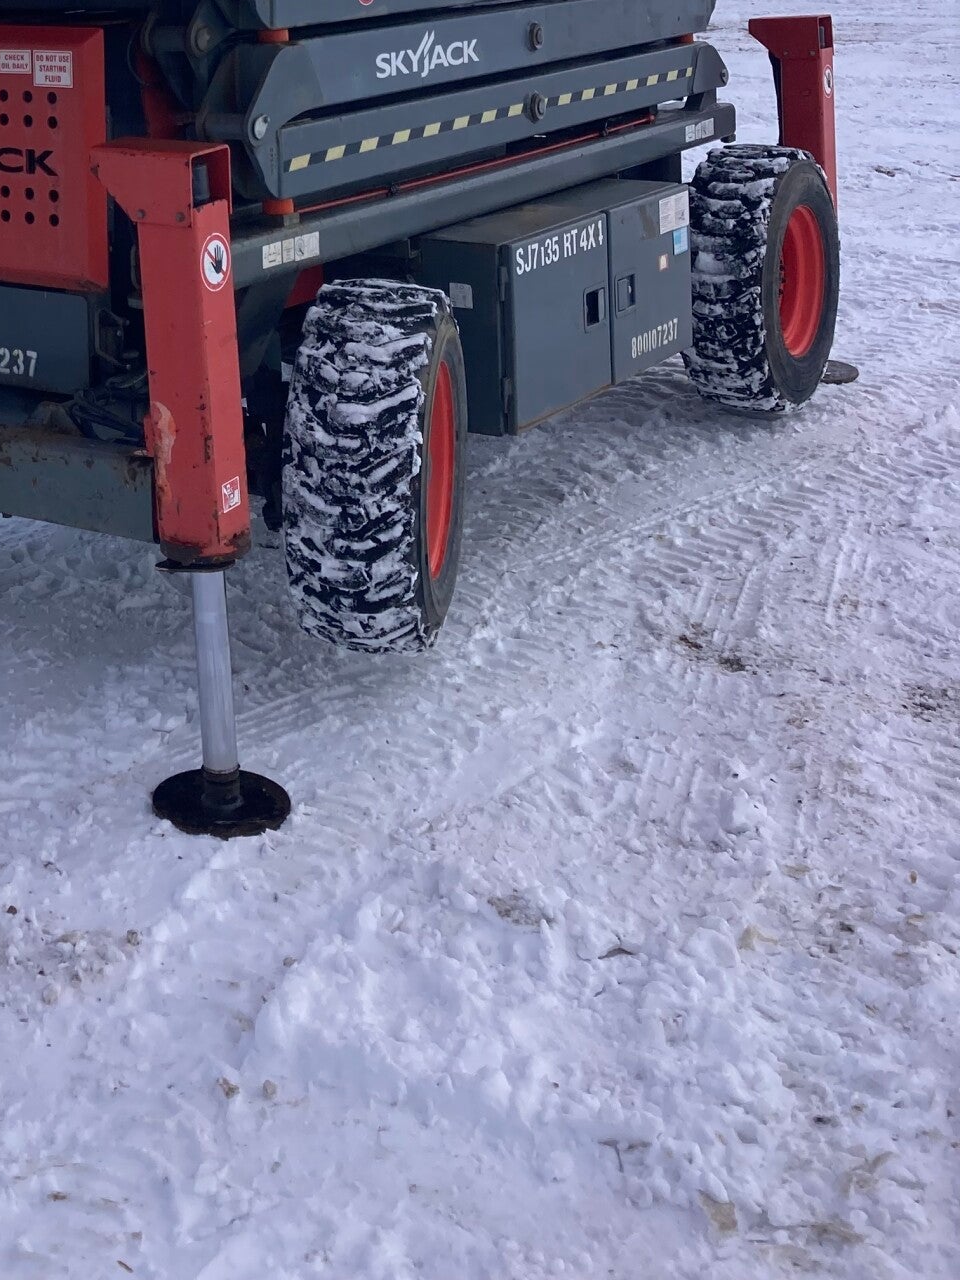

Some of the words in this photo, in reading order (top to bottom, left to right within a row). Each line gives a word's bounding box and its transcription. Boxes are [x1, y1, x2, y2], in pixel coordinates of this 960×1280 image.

[35, 54, 44, 62] DO
[58, 55, 70, 63] USE
[375, 29, 480, 79] SKYJACK
[1, 62, 11, 70] OIL
[38, 64, 67, 73] STARTING
[44, 75, 62, 83] FLUID
[516, 236, 560, 276] SJ7135
[563, 228, 578, 258] RT
[631, 317, 678, 359] 800107237
